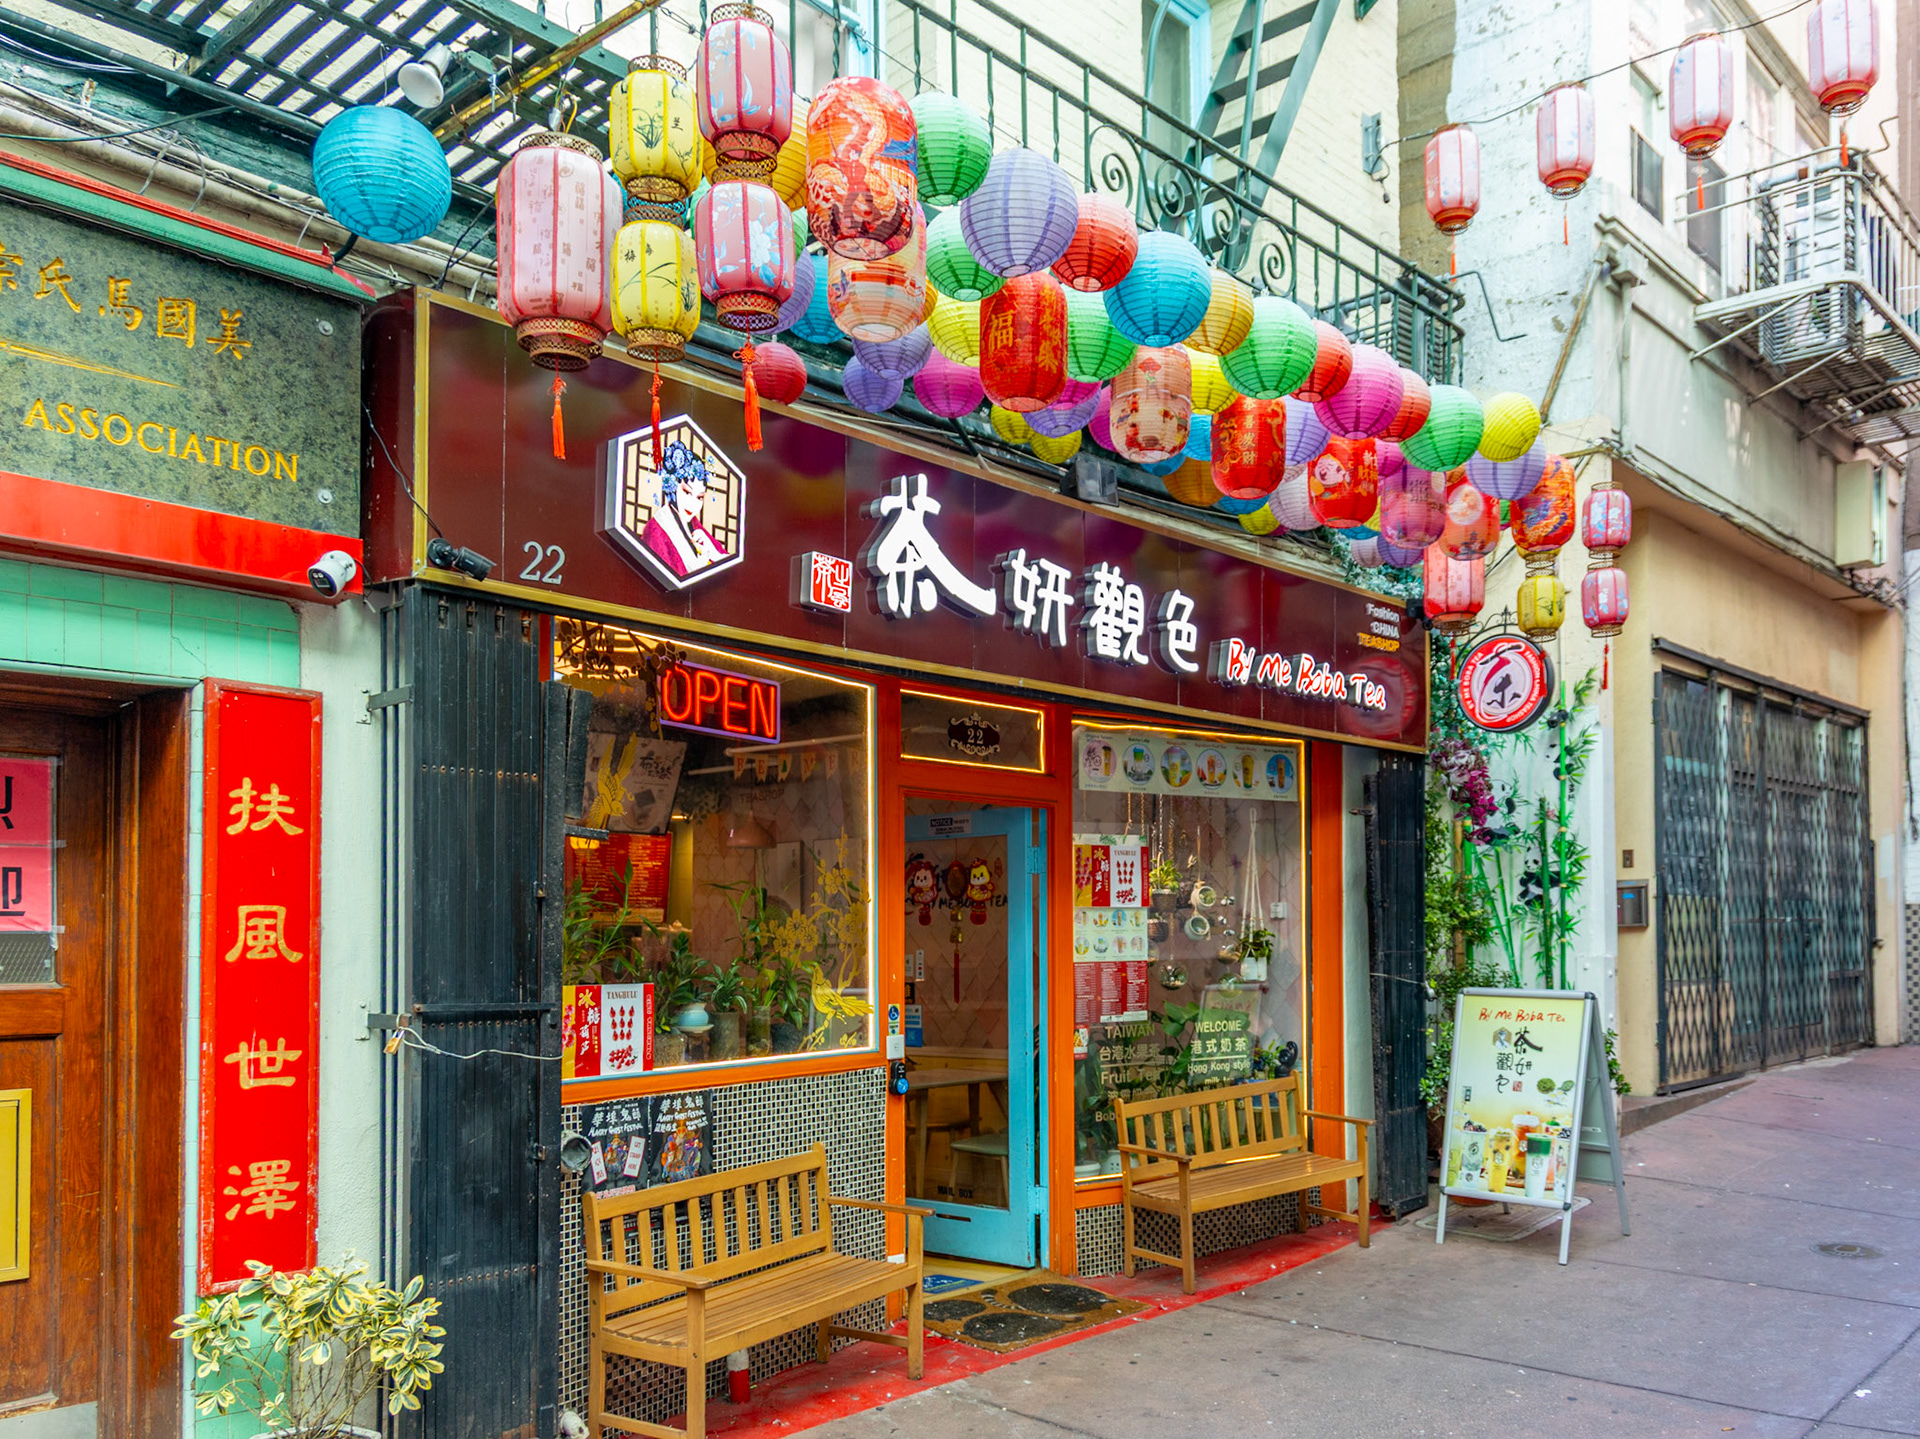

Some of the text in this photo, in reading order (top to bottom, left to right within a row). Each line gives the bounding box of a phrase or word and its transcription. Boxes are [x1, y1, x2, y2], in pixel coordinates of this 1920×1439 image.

[24, 398, 299, 483] ASSOCIATION
[519, 540, 566, 585] 22
[1367, 603, 1400, 623] Fashion
[1371, 621, 1400, 639] CHINA
[1357, 632, 1400, 652] TEASHOP
[1228, 638, 1386, 710] By Me Boba Tea
[1463, 665, 1475, 686] BOBA
[1471, 652, 1484, 664] TEA
[1524, 651, 1541, 679] FASHION
[663, 664, 776, 738] OPEN
[967, 728, 984, 745] 22
[224, 777, 304, 1221] 扶風世澤
[607, 991, 638, 999] TANGHULU
[1478, 1008, 1566, 1022] By Me Boba Tea
[1104, 1024, 1155, 1039] TAIWAN
[1195, 1019, 1242, 1033] WELCOME
[1191, 1037, 1247, 1055] 港式奶茶
[1188, 1059, 1251, 1074] Hong Kong style
[1101, 1067, 1161, 1085] Fruit Tea
[937, 1185, 974, 1199] MAIL BOX
